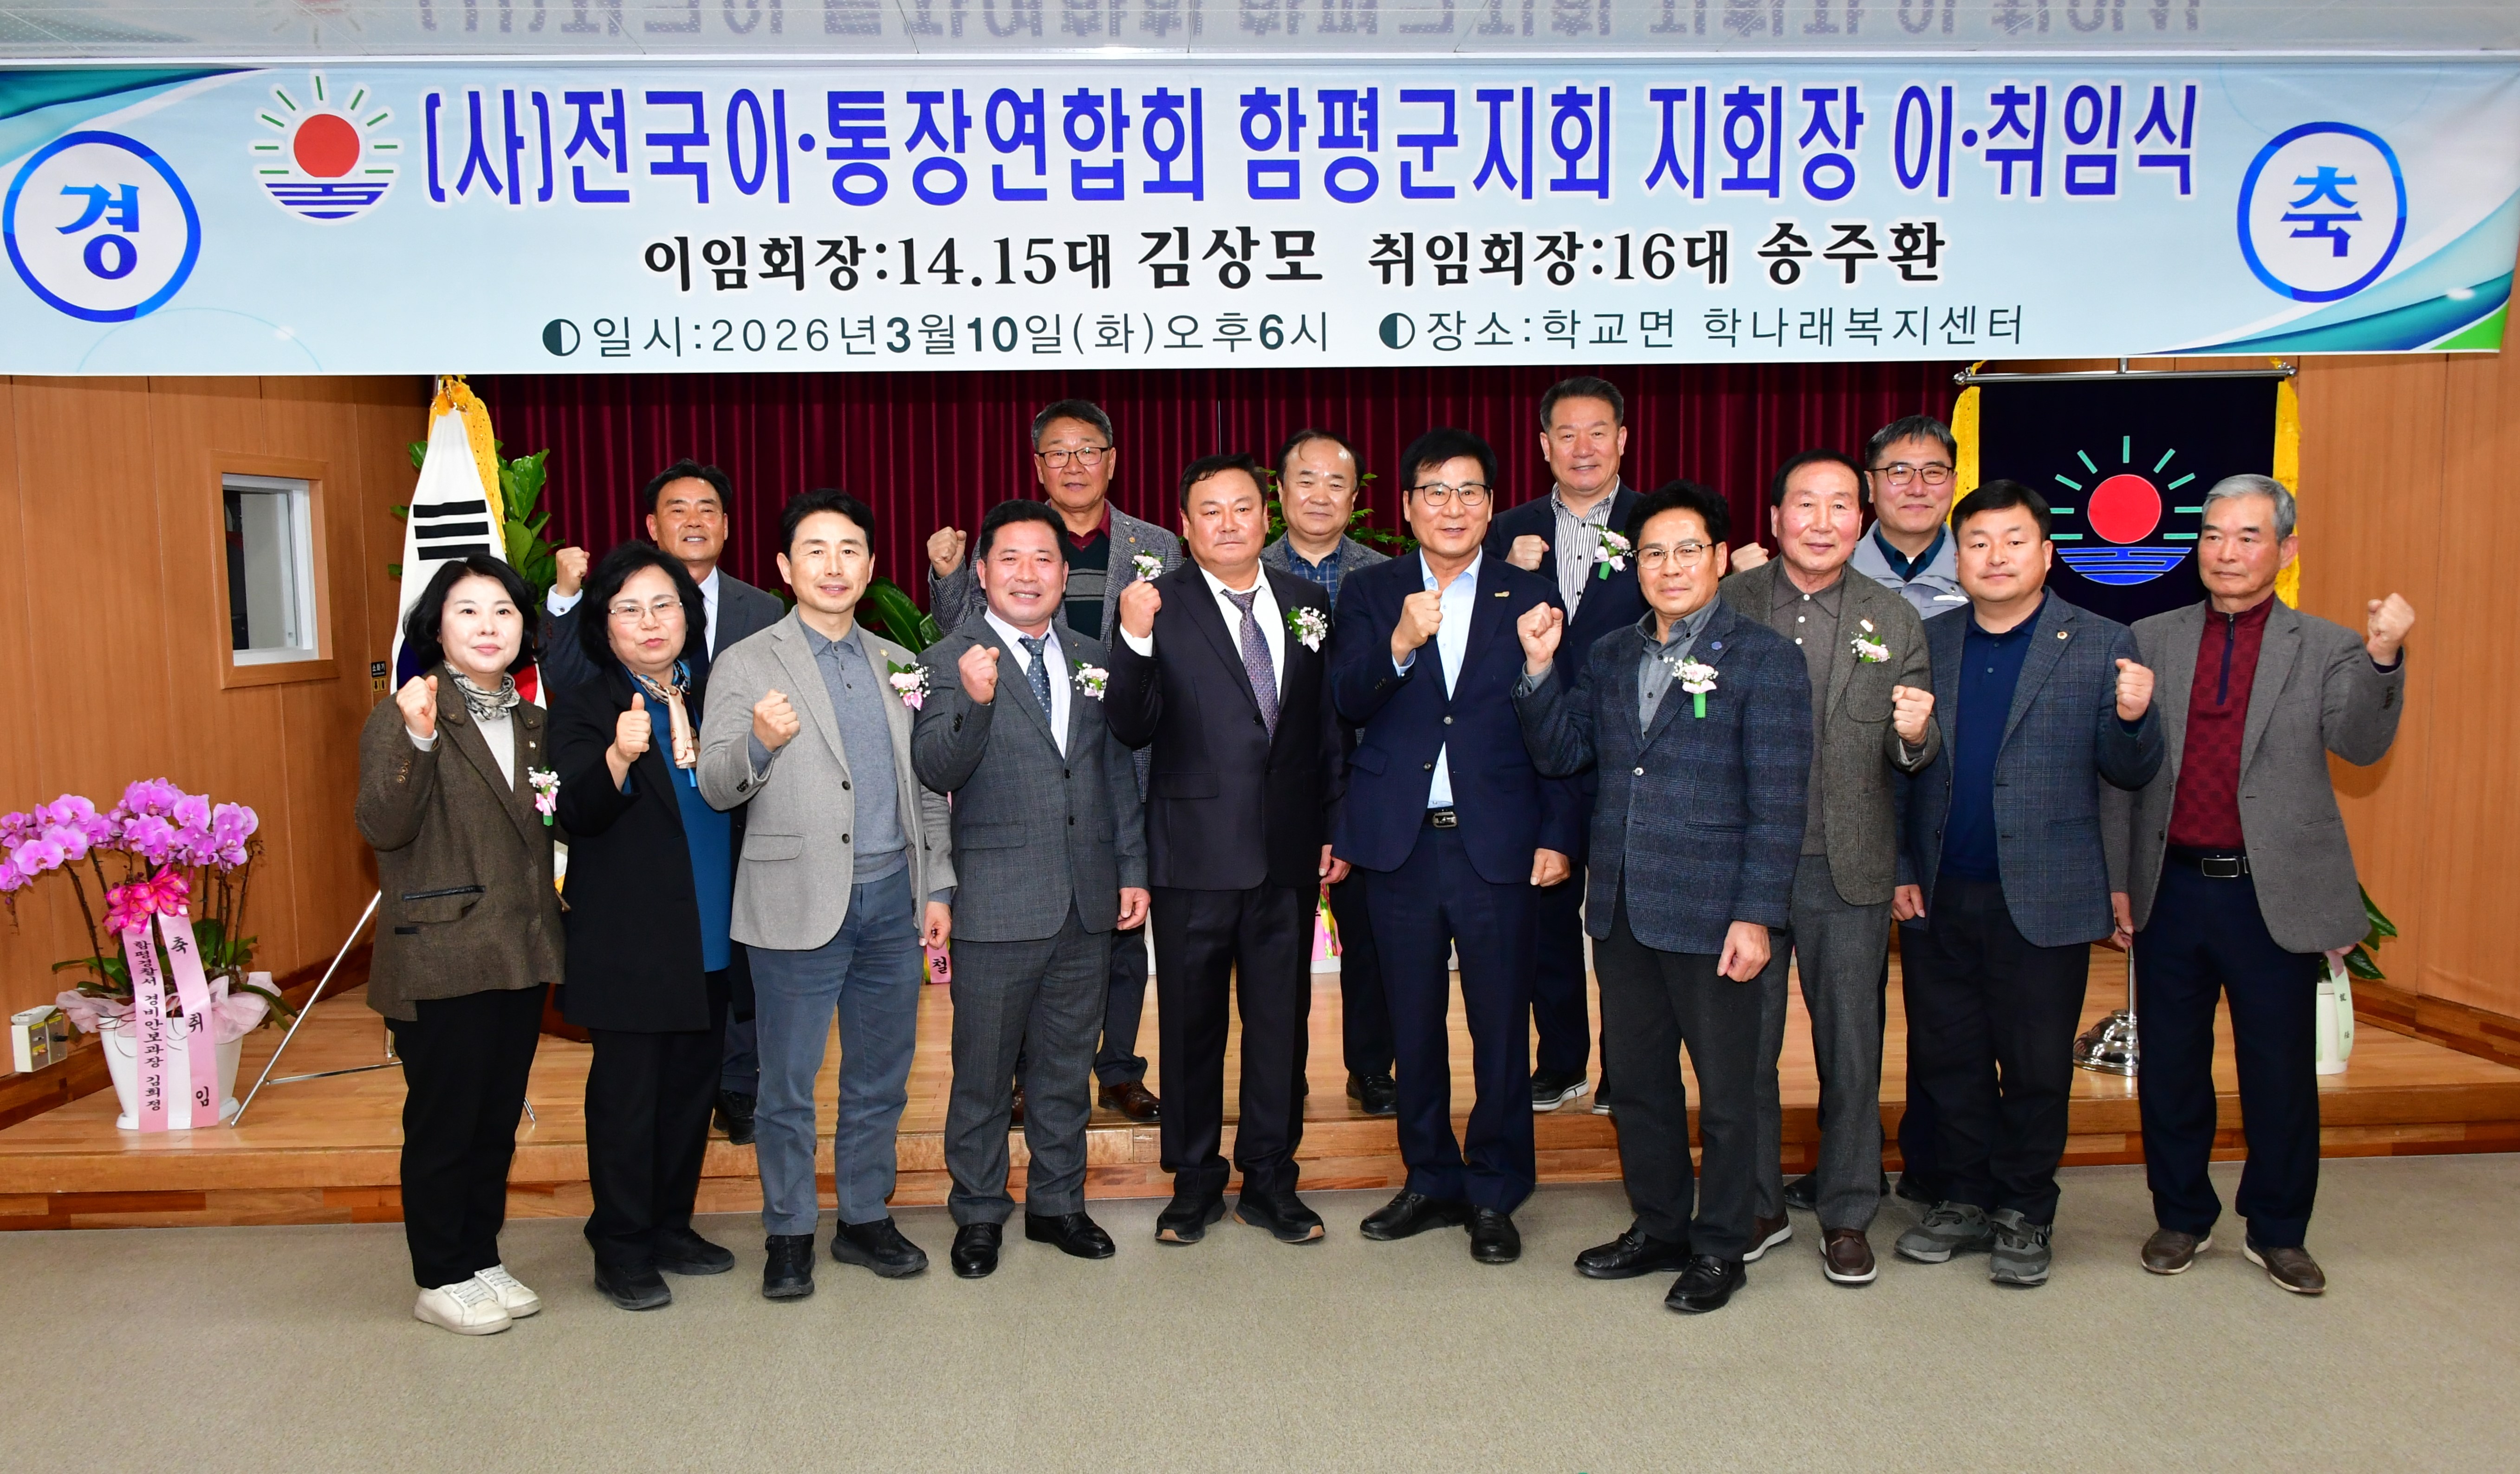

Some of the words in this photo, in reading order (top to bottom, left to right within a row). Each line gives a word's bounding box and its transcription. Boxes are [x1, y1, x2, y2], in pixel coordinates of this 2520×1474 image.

[1241, 86, 1610, 203] 함평군지회
[1646, 86, 1863, 200] 지회장
[1895, 85, 2195, 197] 이·취임식
[56, 184, 139, 279] 경
[2281, 166, 2362, 257] 축
[645, 235, 1110, 291] 이임회장:14.15대
[1139, 226, 1322, 289] 김상모
[1369, 231, 1727, 286] 취임회장:16대
[1758, 222, 1945, 284] 송주환
[1703, 305, 2021, 348] 학나래복지센터
[932, 956, 947, 974] 철
[143, 994, 164, 1067] 경비안보과장
[171, 936, 188, 954] 축
[188, 1012, 203, 1033] 취
[196, 1086, 209, 1107] 임
[146, 1074, 161, 1111] 김희정
